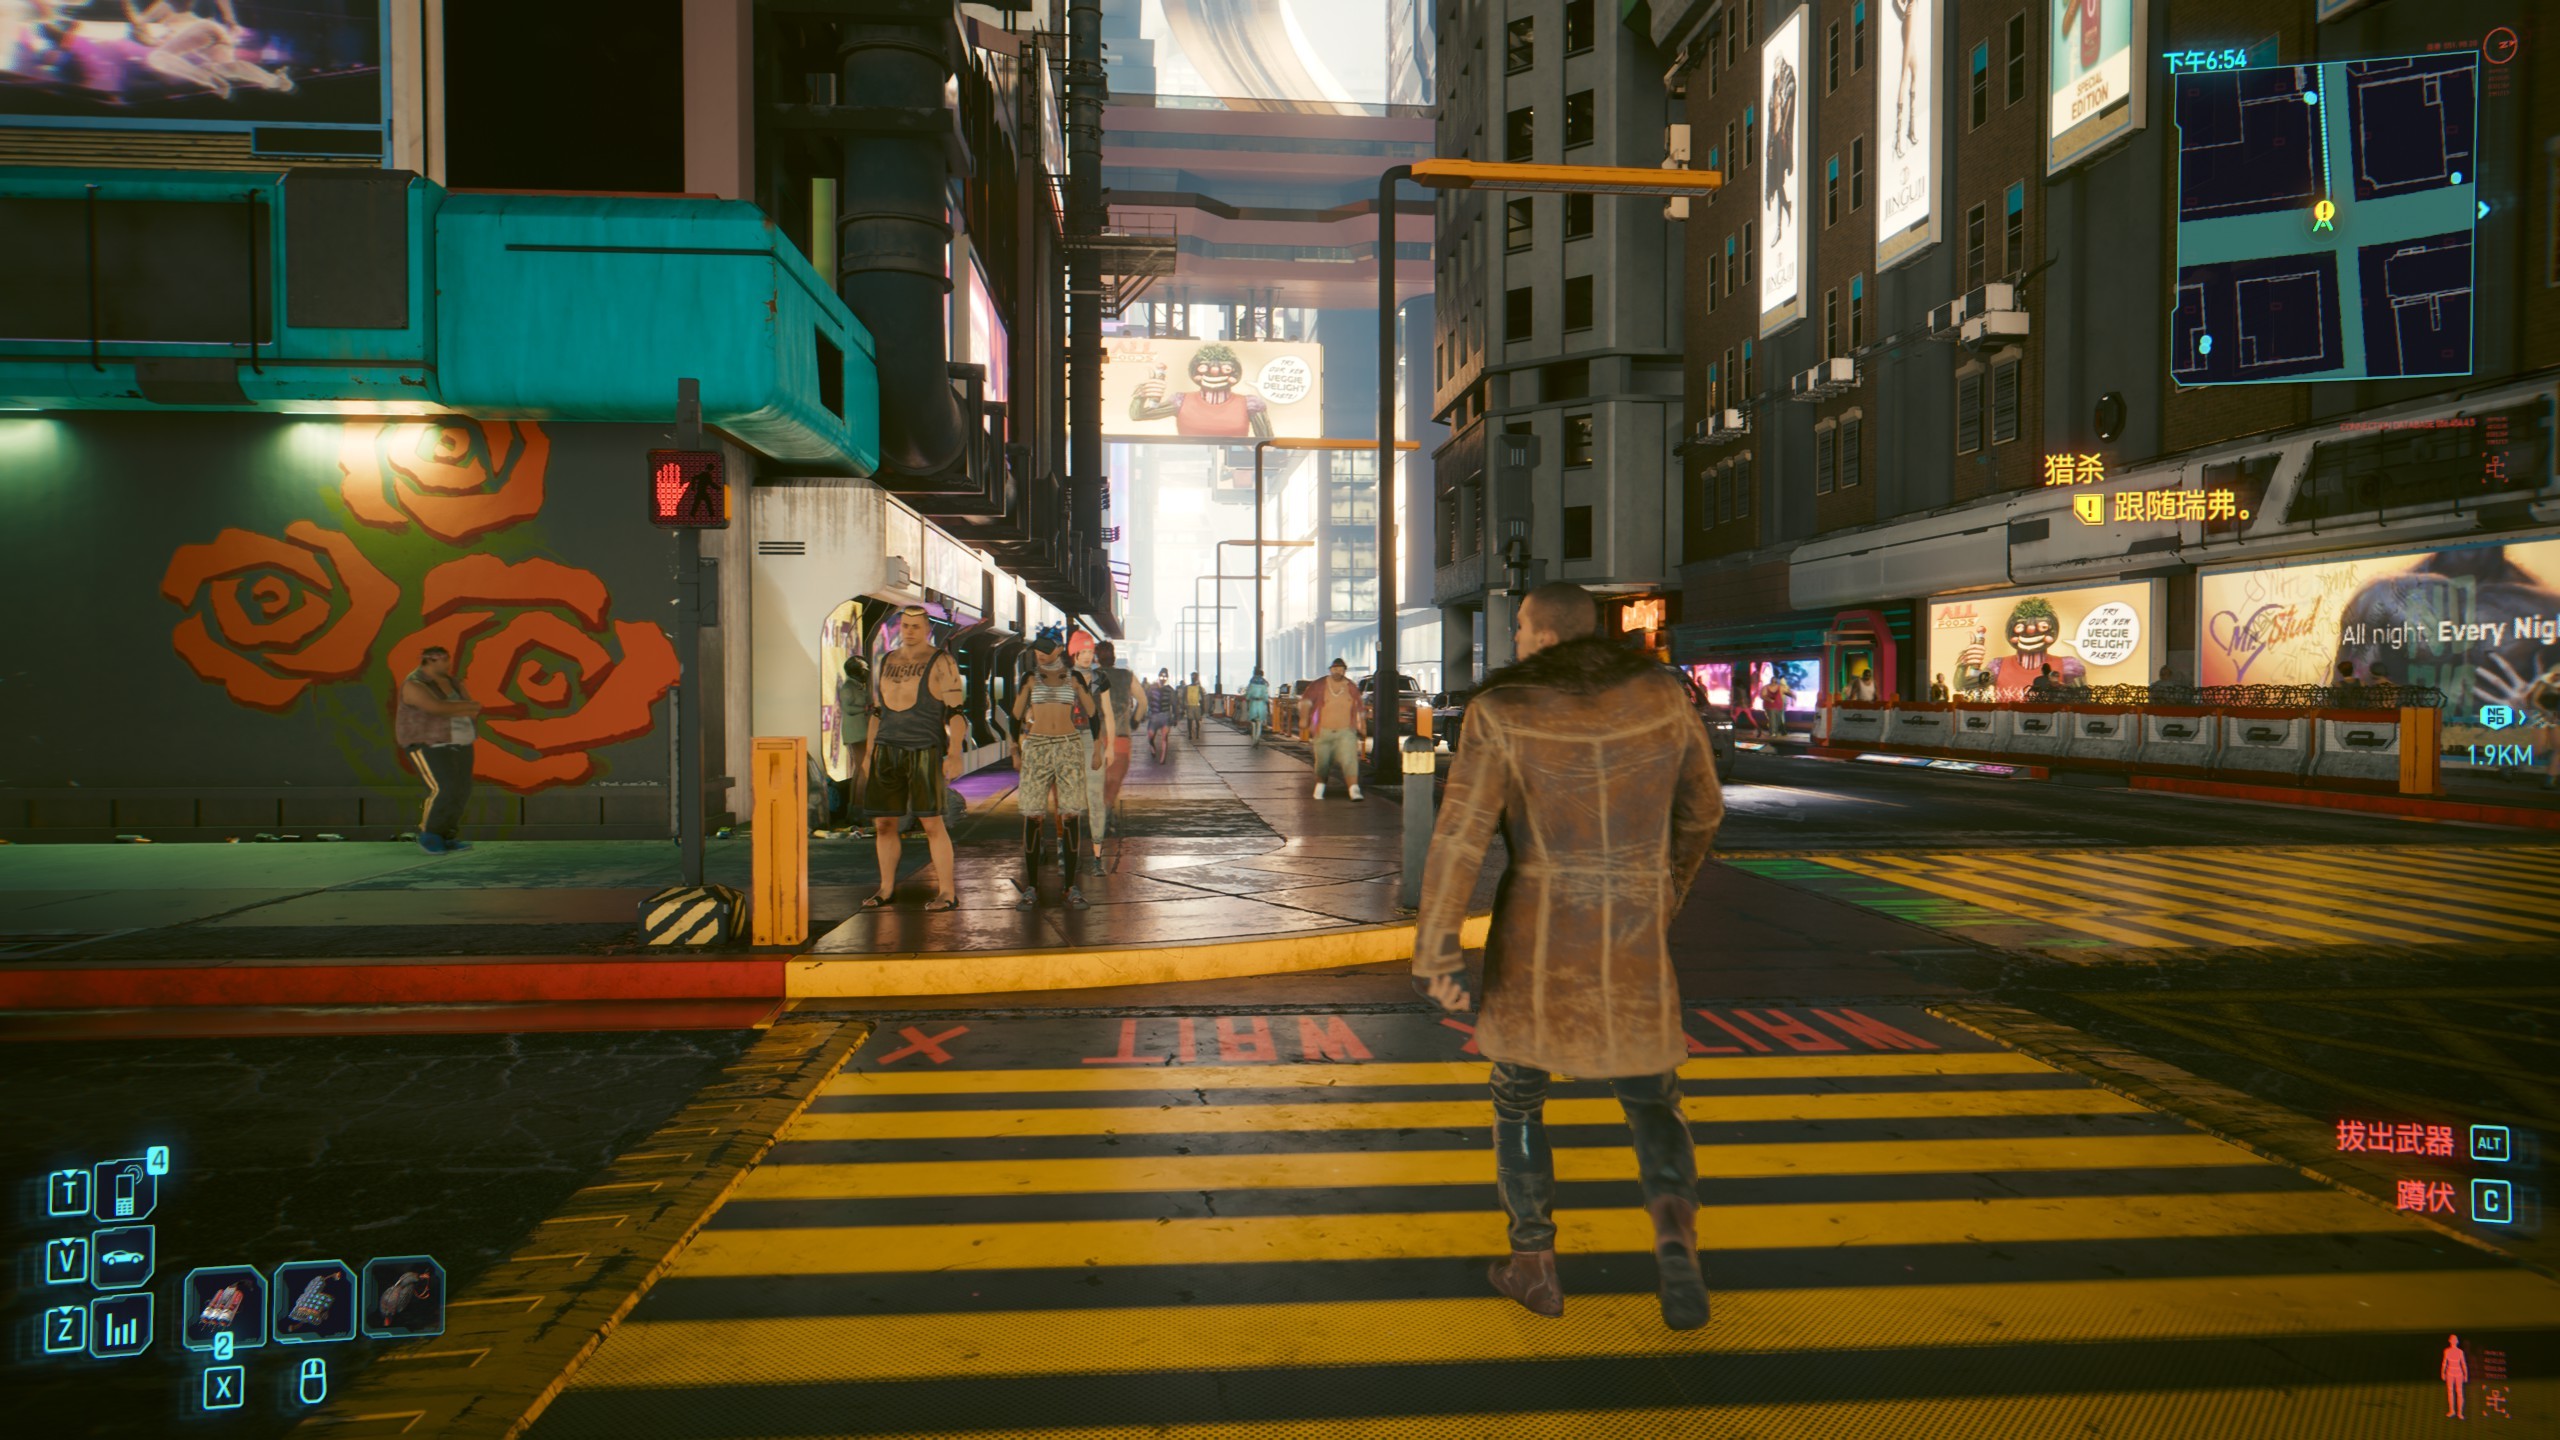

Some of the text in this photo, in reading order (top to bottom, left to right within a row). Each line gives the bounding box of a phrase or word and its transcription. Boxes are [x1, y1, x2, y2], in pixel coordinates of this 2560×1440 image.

[2077, 71, 2103, 96] SPECIAL
[2071, 81, 2109, 121] EDITION
[1267, 374, 1303, 382] VEGGIE
[1263, 383, 1306, 392] DELIGHT
[1936, 603, 1978, 619] ALL
[2103, 608, 2119, 616] TRY
[1937, 618, 1976, 627] FOODS
[2088, 617, 2131, 626] OUR NEW
[2268, 595, 2323, 646] Stud
[2087, 628, 2129, 638] VEGGIE
[2342, 623, 2365, 646] All
[2373, 622, 2429, 650] night.
[2438, 620, 2508, 647] Every
[2082, 639, 2133, 649] DELIGHT
[2089, 651, 2122, 660] PASTE!
[1081, 1016, 1375, 1064] WAIT
